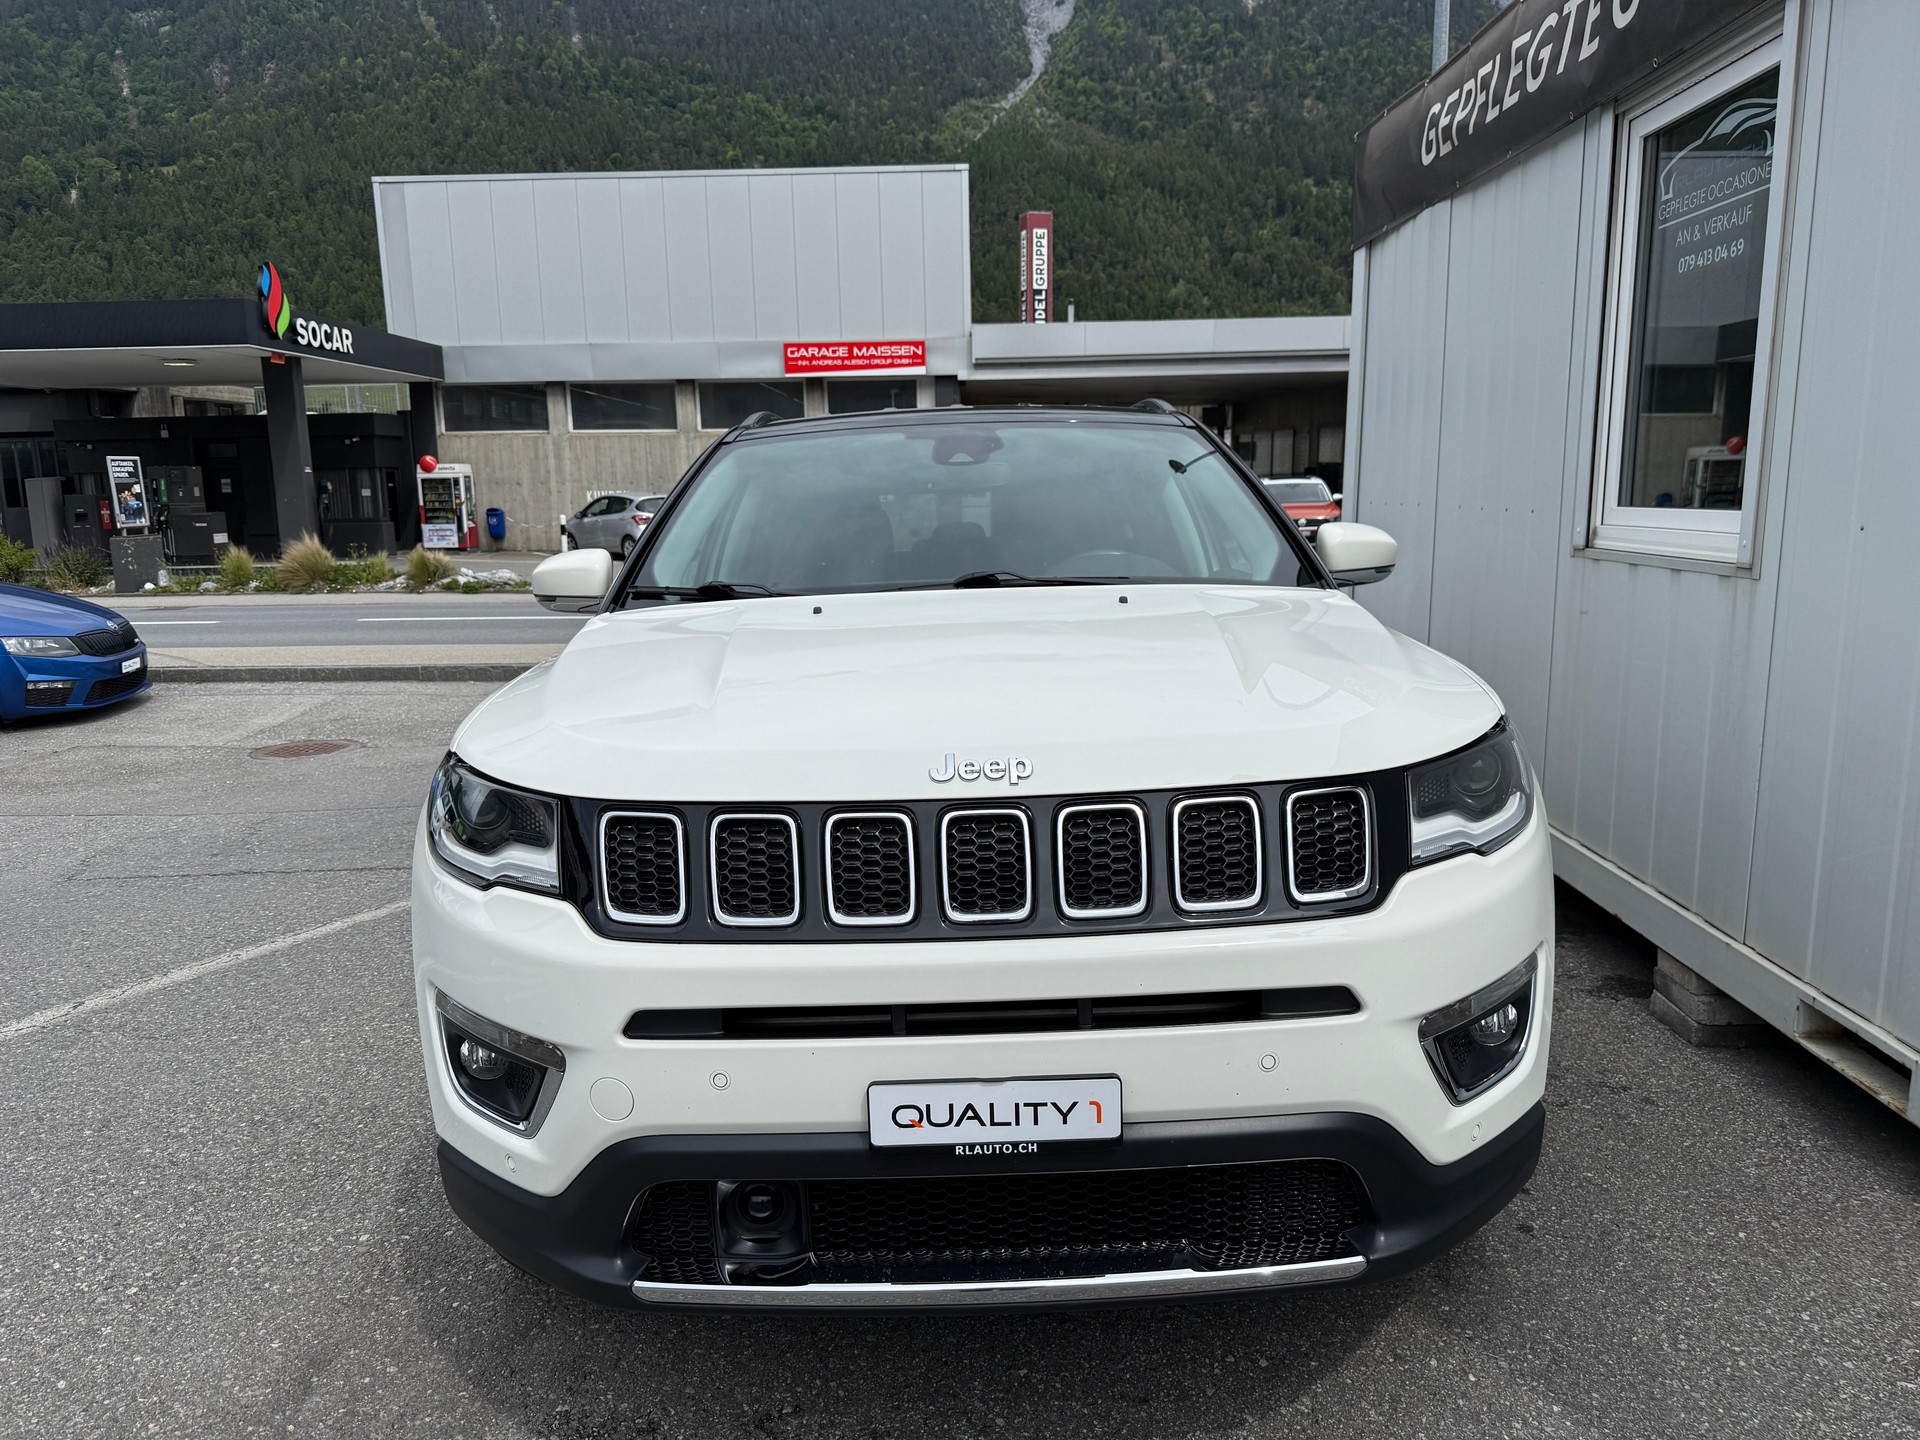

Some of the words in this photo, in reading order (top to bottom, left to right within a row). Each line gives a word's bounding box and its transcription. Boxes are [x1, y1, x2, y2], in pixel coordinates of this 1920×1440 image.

[1658, 187, 1707, 220] GEPFLEGTE
[1676, 226, 1691, 247] AN
[1694, 224, 1701, 241] &
[1704, 204, 1753, 236] VERKAUF
[1035, 231, 1045, 287] GRUPPE
[1678, 253, 1695, 274] 079
[1697, 248, 1712, 267] 413
[1715, 243, 1728, 261] 04
[1730, 238, 1744, 256] 69
[296, 317, 354, 354] SOCAR
[787, 346, 849, 358] GARAGE
[853, 345, 923, 357] MAISSEN
[928, 753, 1033, 786] Jeep
[891, 1101, 1079, 1129] QUALITY
[955, 1142, 1038, 1155] RLAUTO.CH
